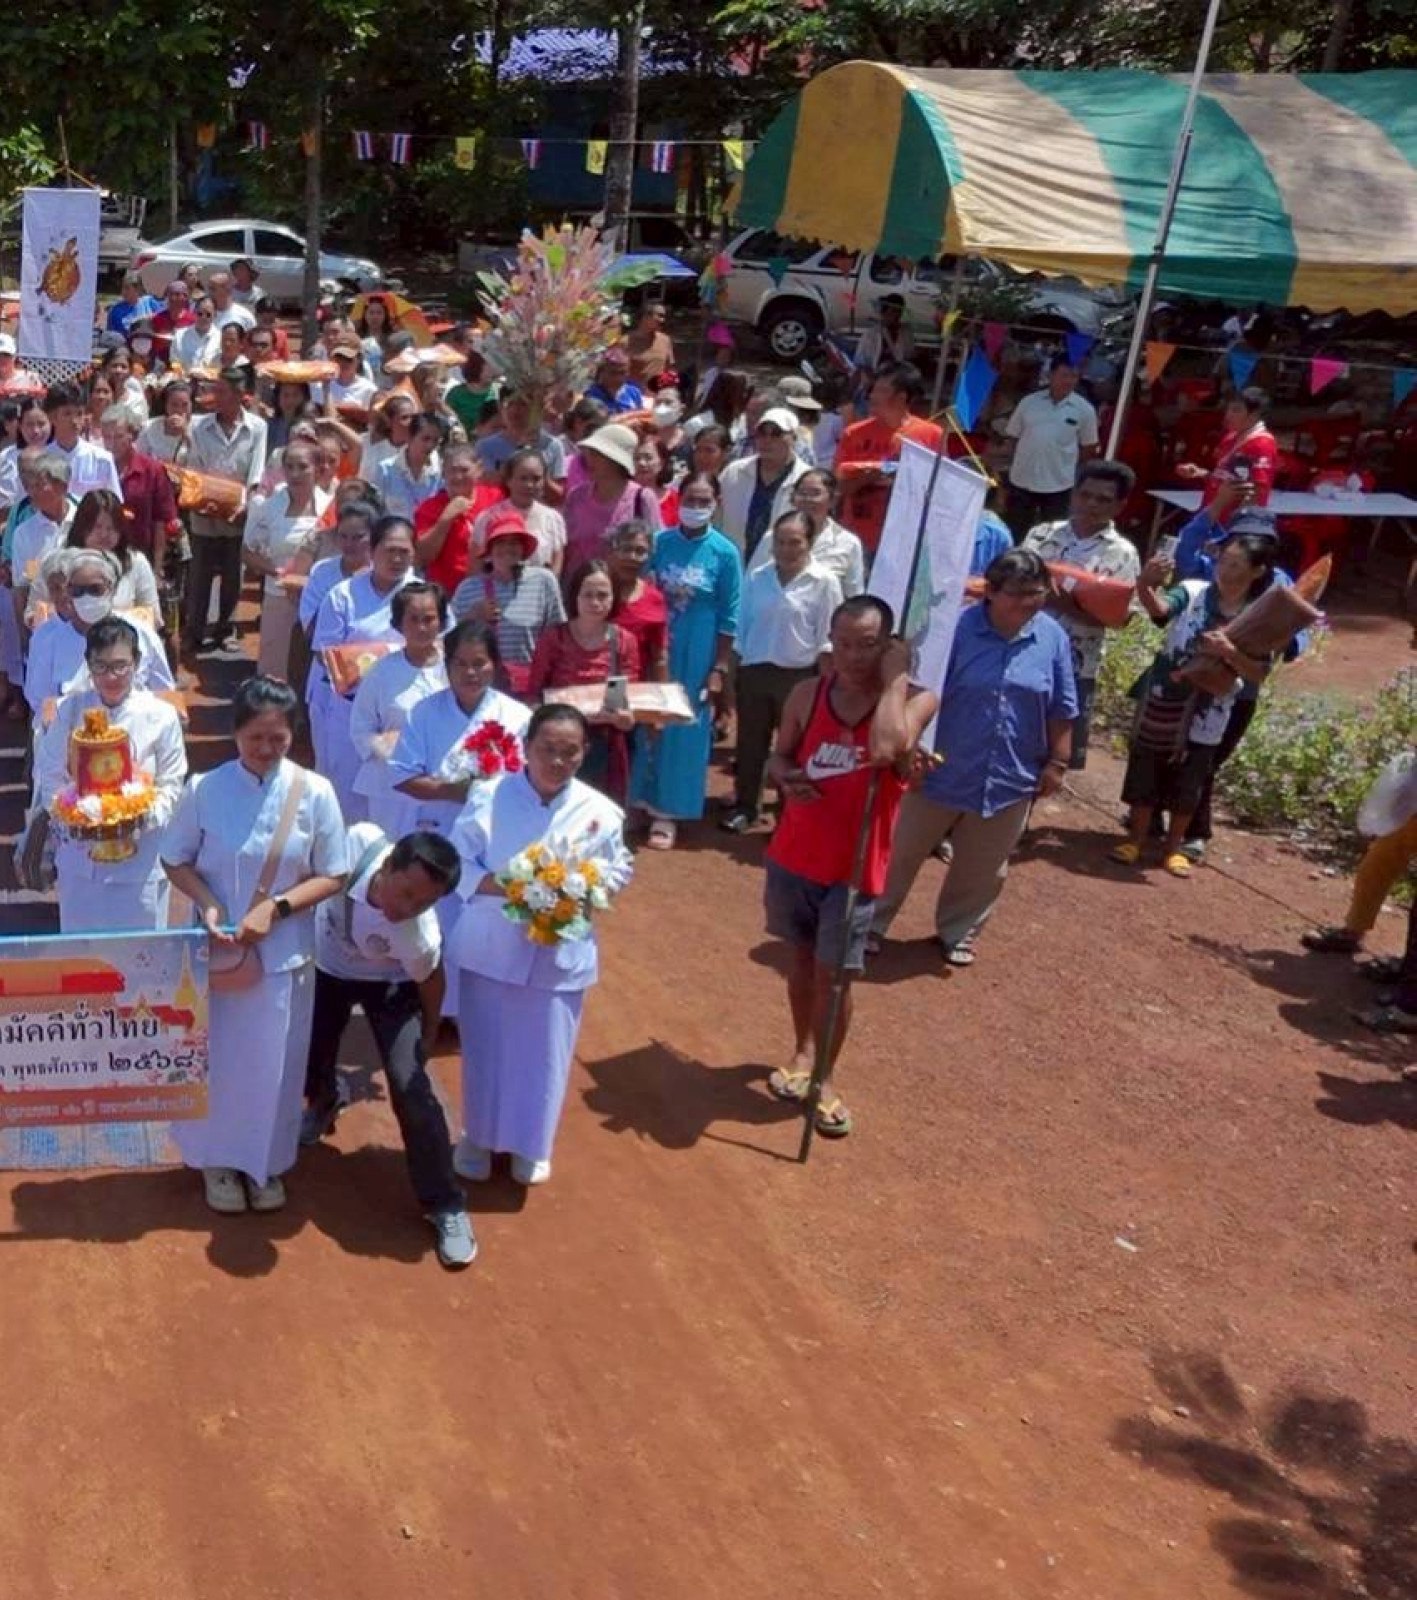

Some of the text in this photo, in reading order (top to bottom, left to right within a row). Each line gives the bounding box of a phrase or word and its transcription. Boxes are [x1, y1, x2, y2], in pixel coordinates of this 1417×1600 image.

[12, 1056, 98, 1081] พุทธศักราช
[108, 1049, 195, 1072] ๒๕๖๘
